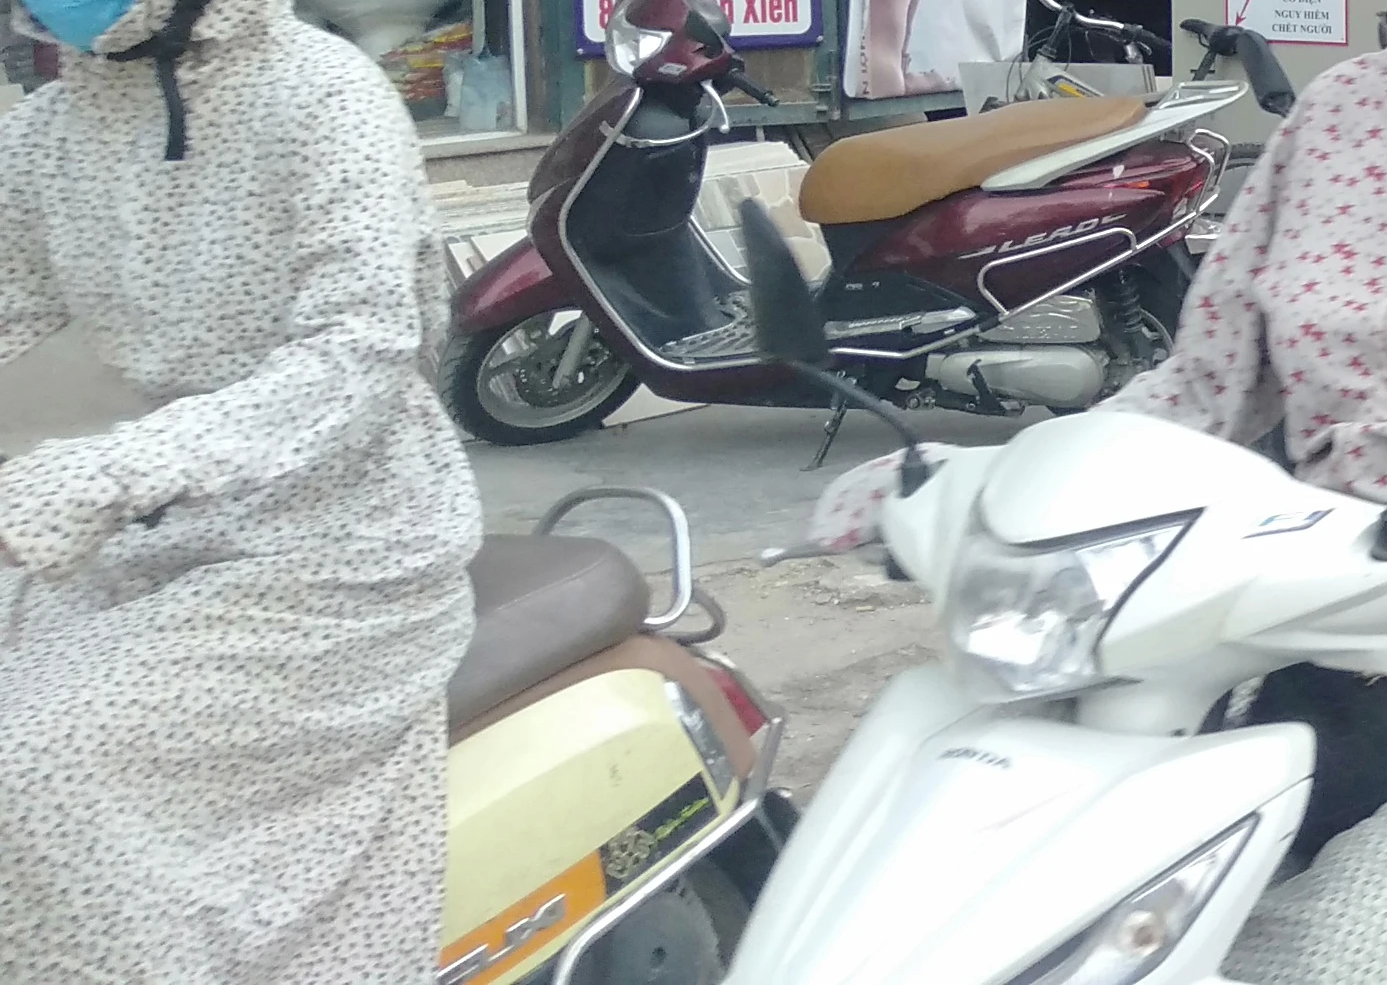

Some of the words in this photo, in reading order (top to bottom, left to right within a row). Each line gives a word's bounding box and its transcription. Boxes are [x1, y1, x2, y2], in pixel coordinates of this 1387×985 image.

[1275, 10, 1302, 20] NGUY
[1303, 9, 1330, 20] HIỂM
[1272, 22, 1298, 33] CHẾT
[1300, 24, 1332, 34] NGƯỜI
[998, 218, 1099, 253] LEAD
